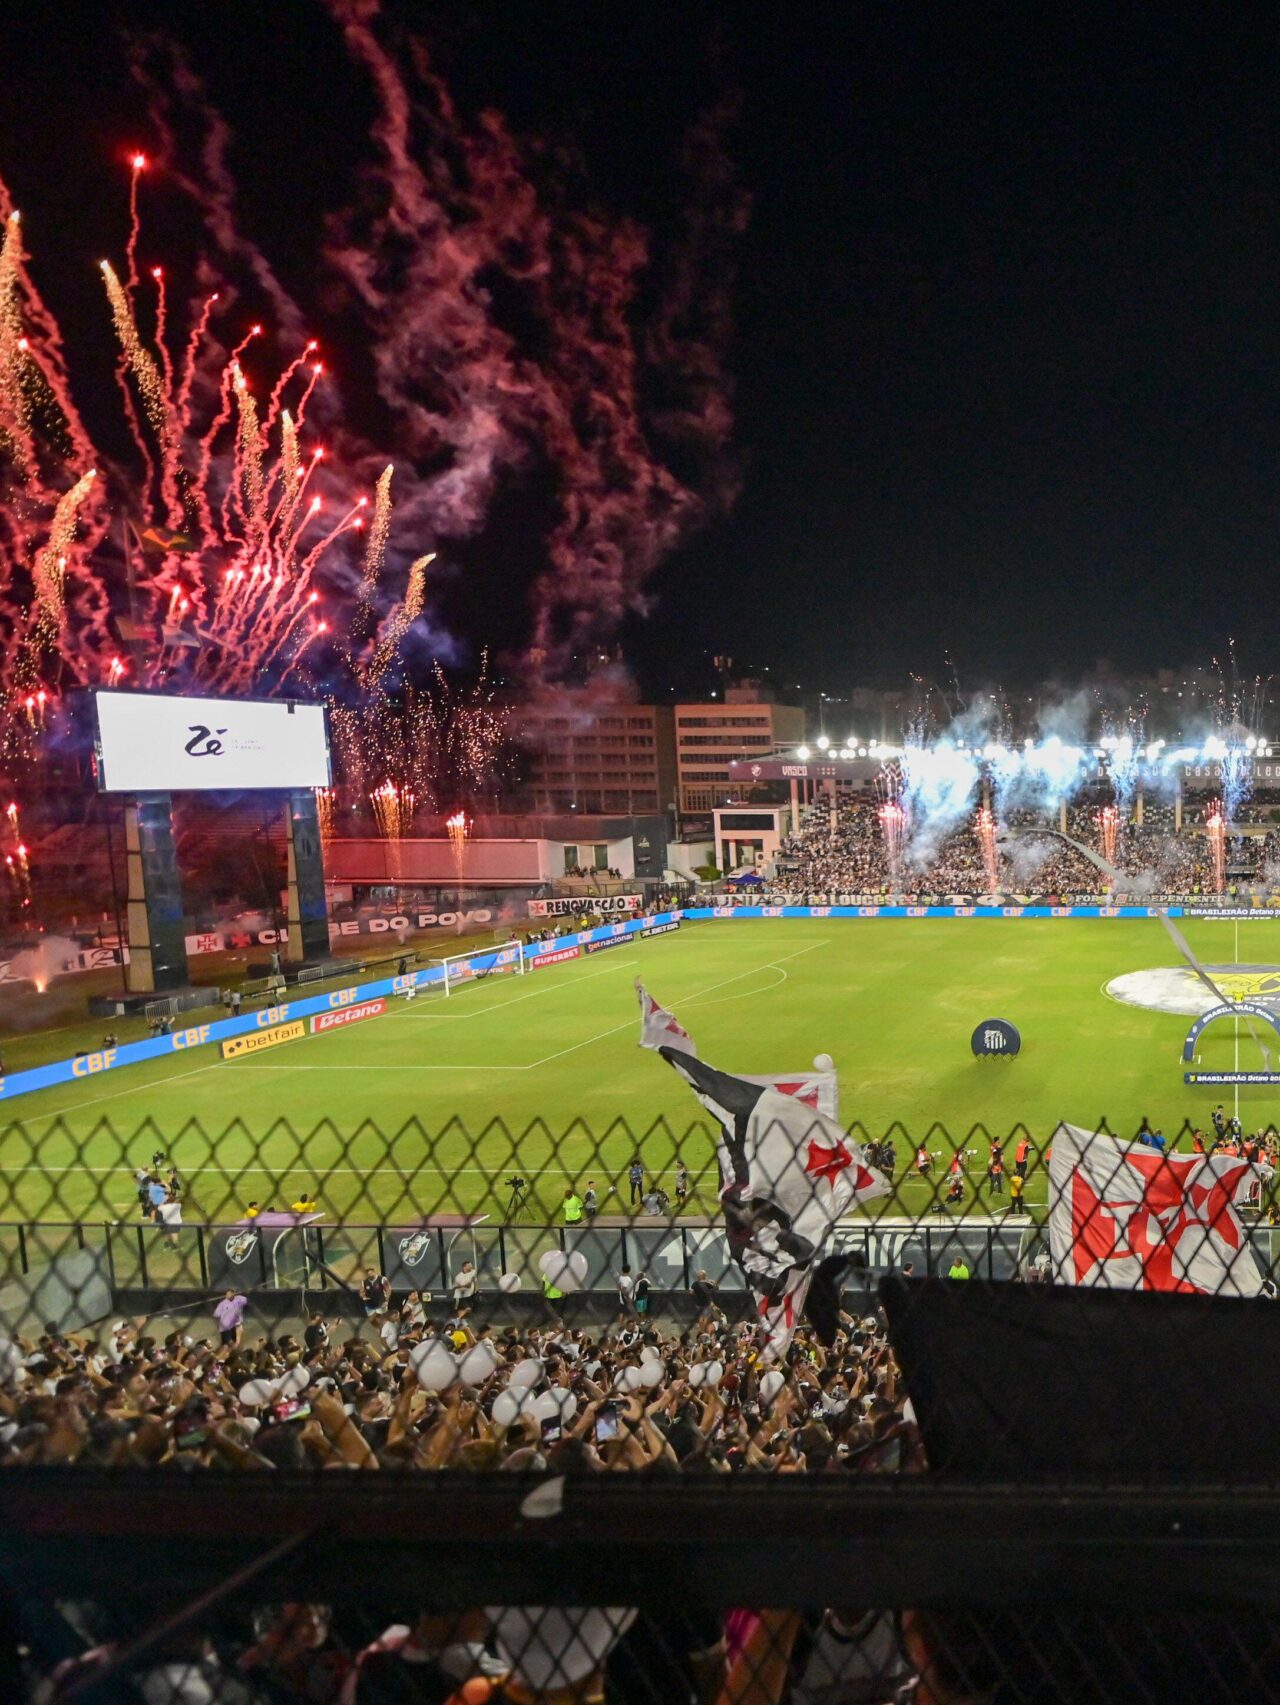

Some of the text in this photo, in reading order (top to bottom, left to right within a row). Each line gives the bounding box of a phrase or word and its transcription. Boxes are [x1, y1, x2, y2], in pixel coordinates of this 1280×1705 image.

[185, 725, 228, 756] Zé
[782, 765, 808, 777] VASCO
[713, 907, 735, 917] CBF
[762, 907, 784, 917] CBF
[810, 907, 832, 917] CBF
[858, 907, 880, 917] CBF
[907, 907, 928, 917] CBF
[955, 907, 976, 917] CBF
[1003, 907, 1024, 917] CBF
[1051, 907, 1073, 917] CBF
[1099, 907, 1120, 917] CBF
[369, 916, 409, 932] DO
[419, 908, 491, 928] POVO
[534, 947, 579, 965] SUPERBET
[329, 987, 358, 1008] CBF
[257, 1004, 290, 1027] CBF
[319, 1003, 382, 1029] Betano
[172, 1025, 210, 1050] CBF
[246, 1025, 300, 1049] betfair
[72, 1049, 117, 1077] CBF
